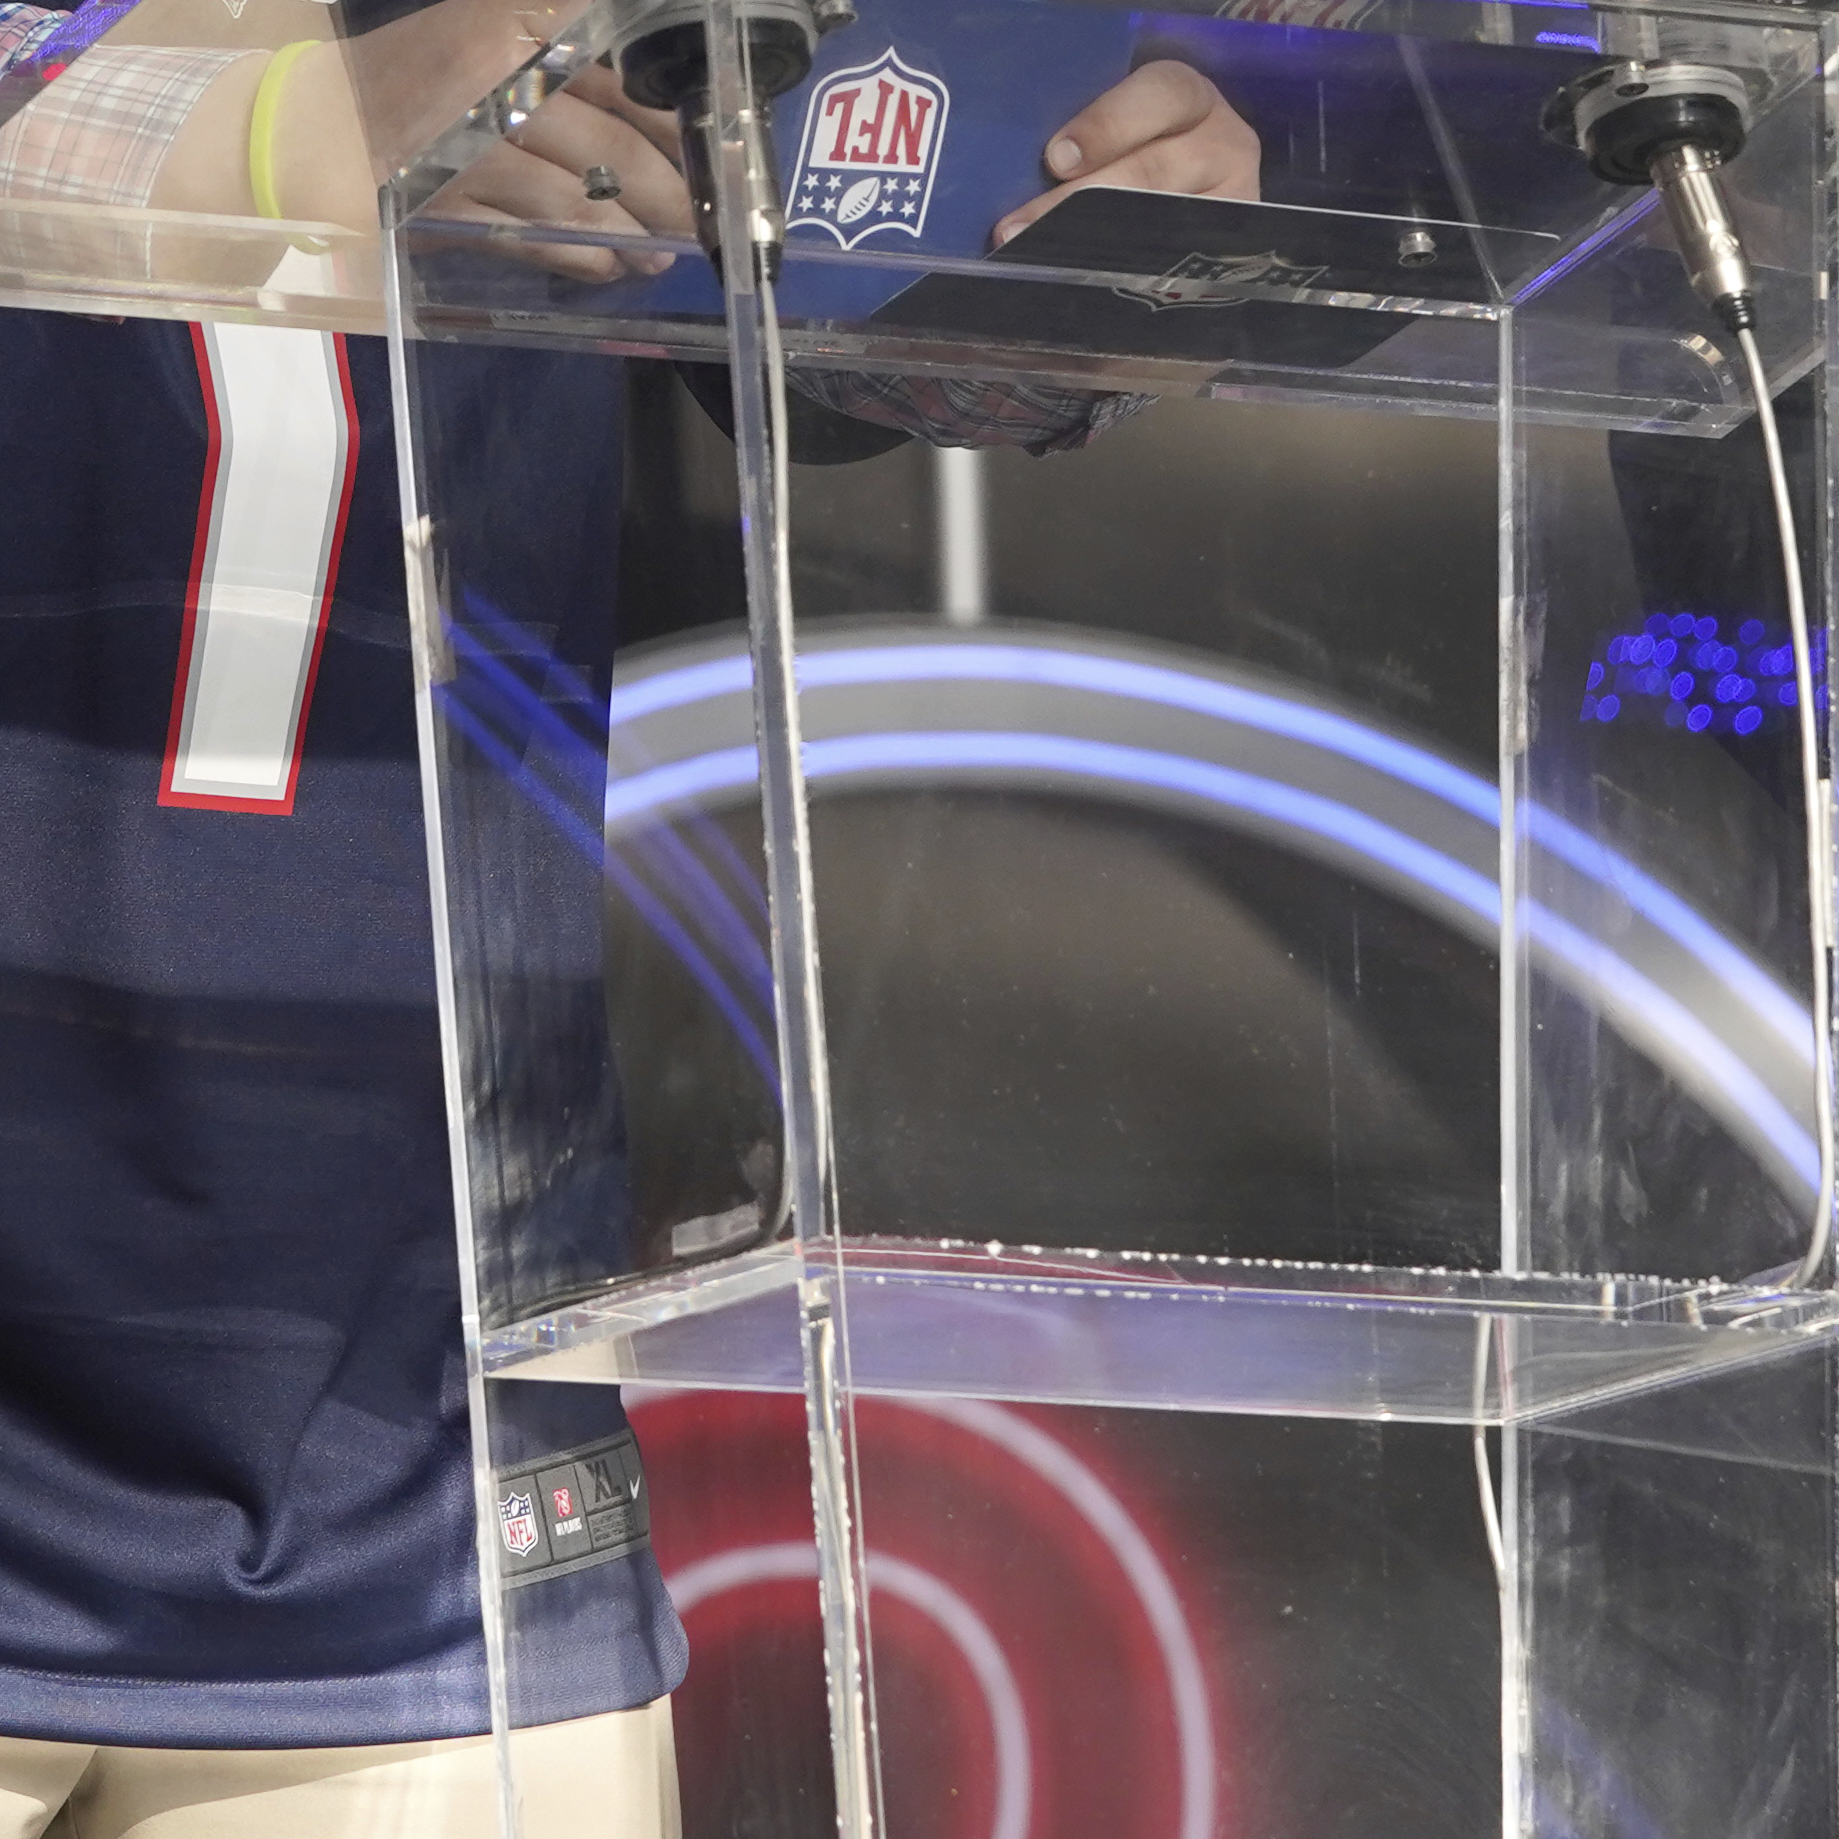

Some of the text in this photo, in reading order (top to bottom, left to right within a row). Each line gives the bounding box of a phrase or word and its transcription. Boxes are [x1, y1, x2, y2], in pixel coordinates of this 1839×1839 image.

[825, 78, 933, 166] NFL
[157, 244, 360, 816] 1
[585, 1459, 623, 1503] XL
[506, 1518, 533, 1547] NFL
